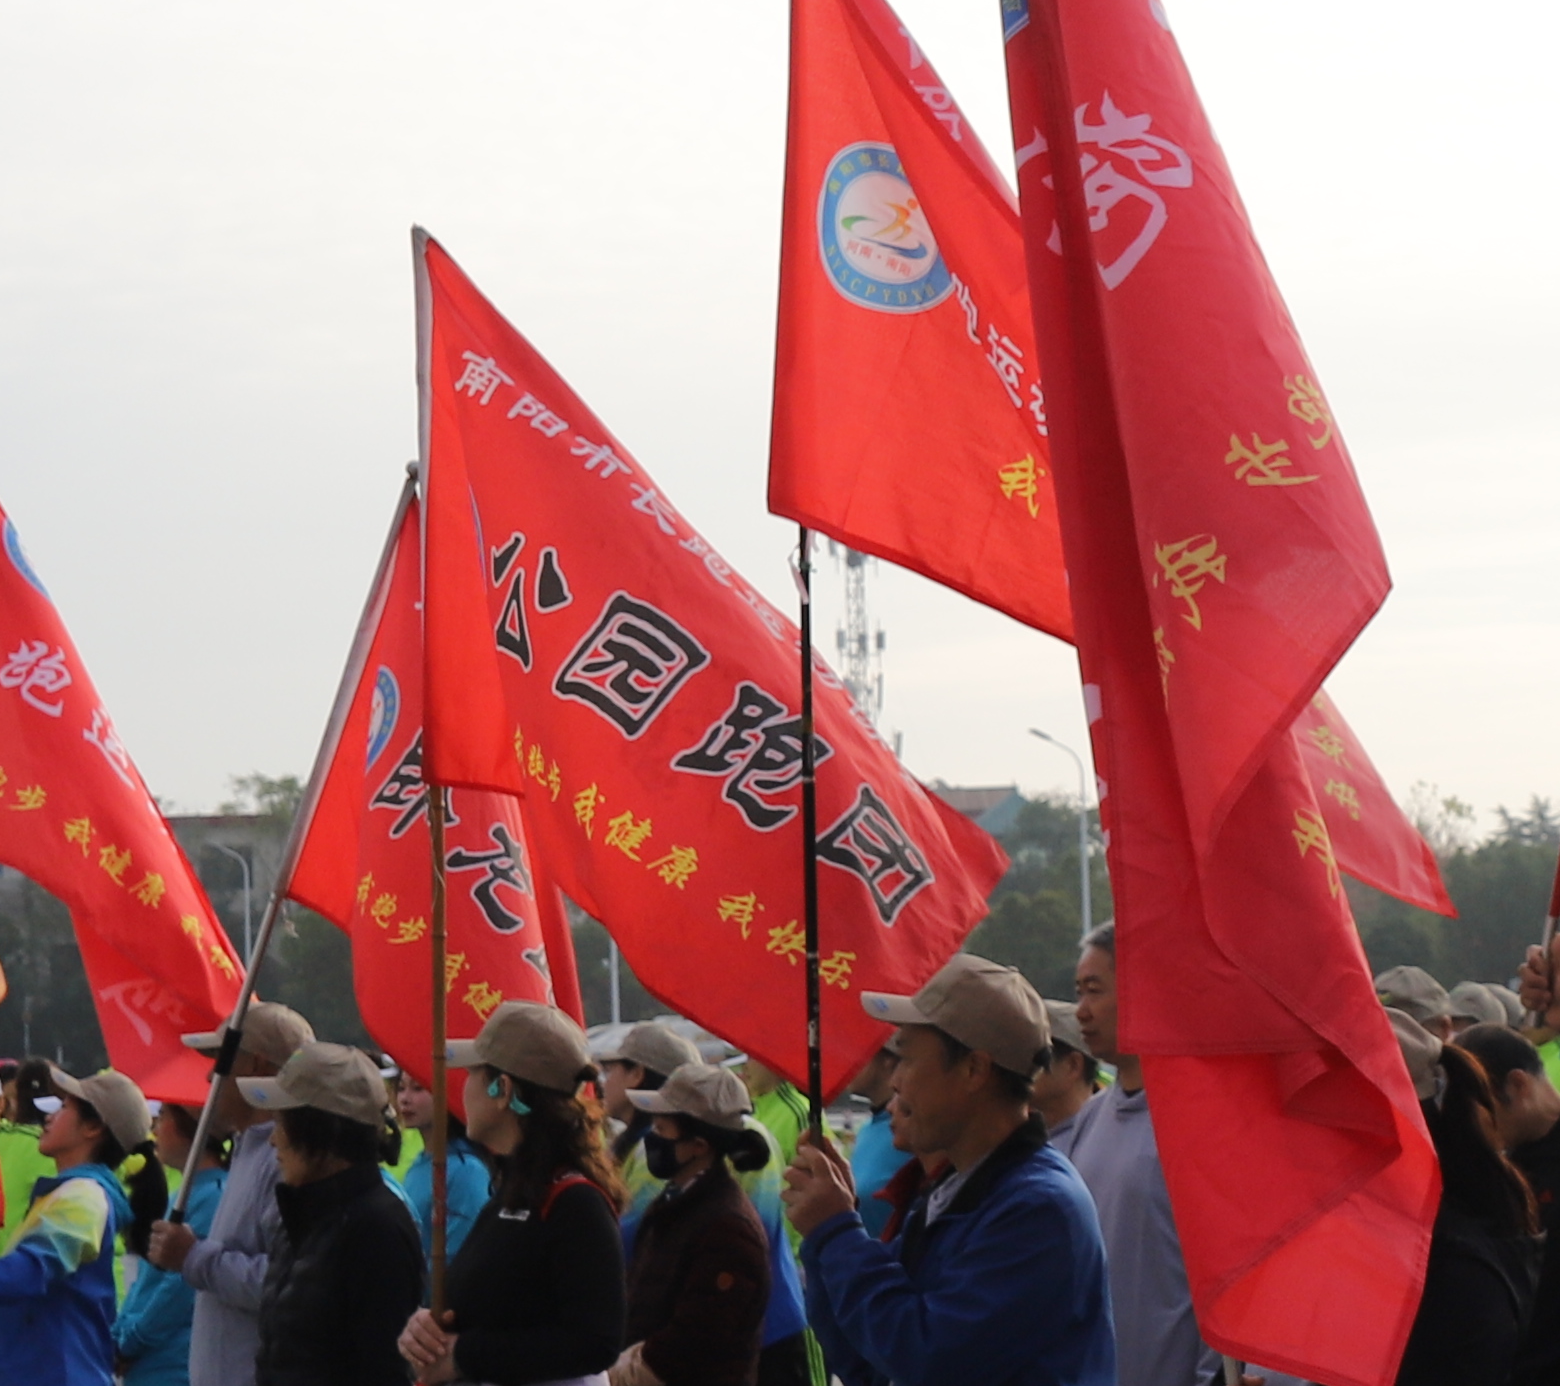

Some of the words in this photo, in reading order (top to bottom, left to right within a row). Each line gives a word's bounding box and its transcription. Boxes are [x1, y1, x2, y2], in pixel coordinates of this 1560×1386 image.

[62, 815, 168, 910] 我健康
[572, 781, 700, 891] 我健康
